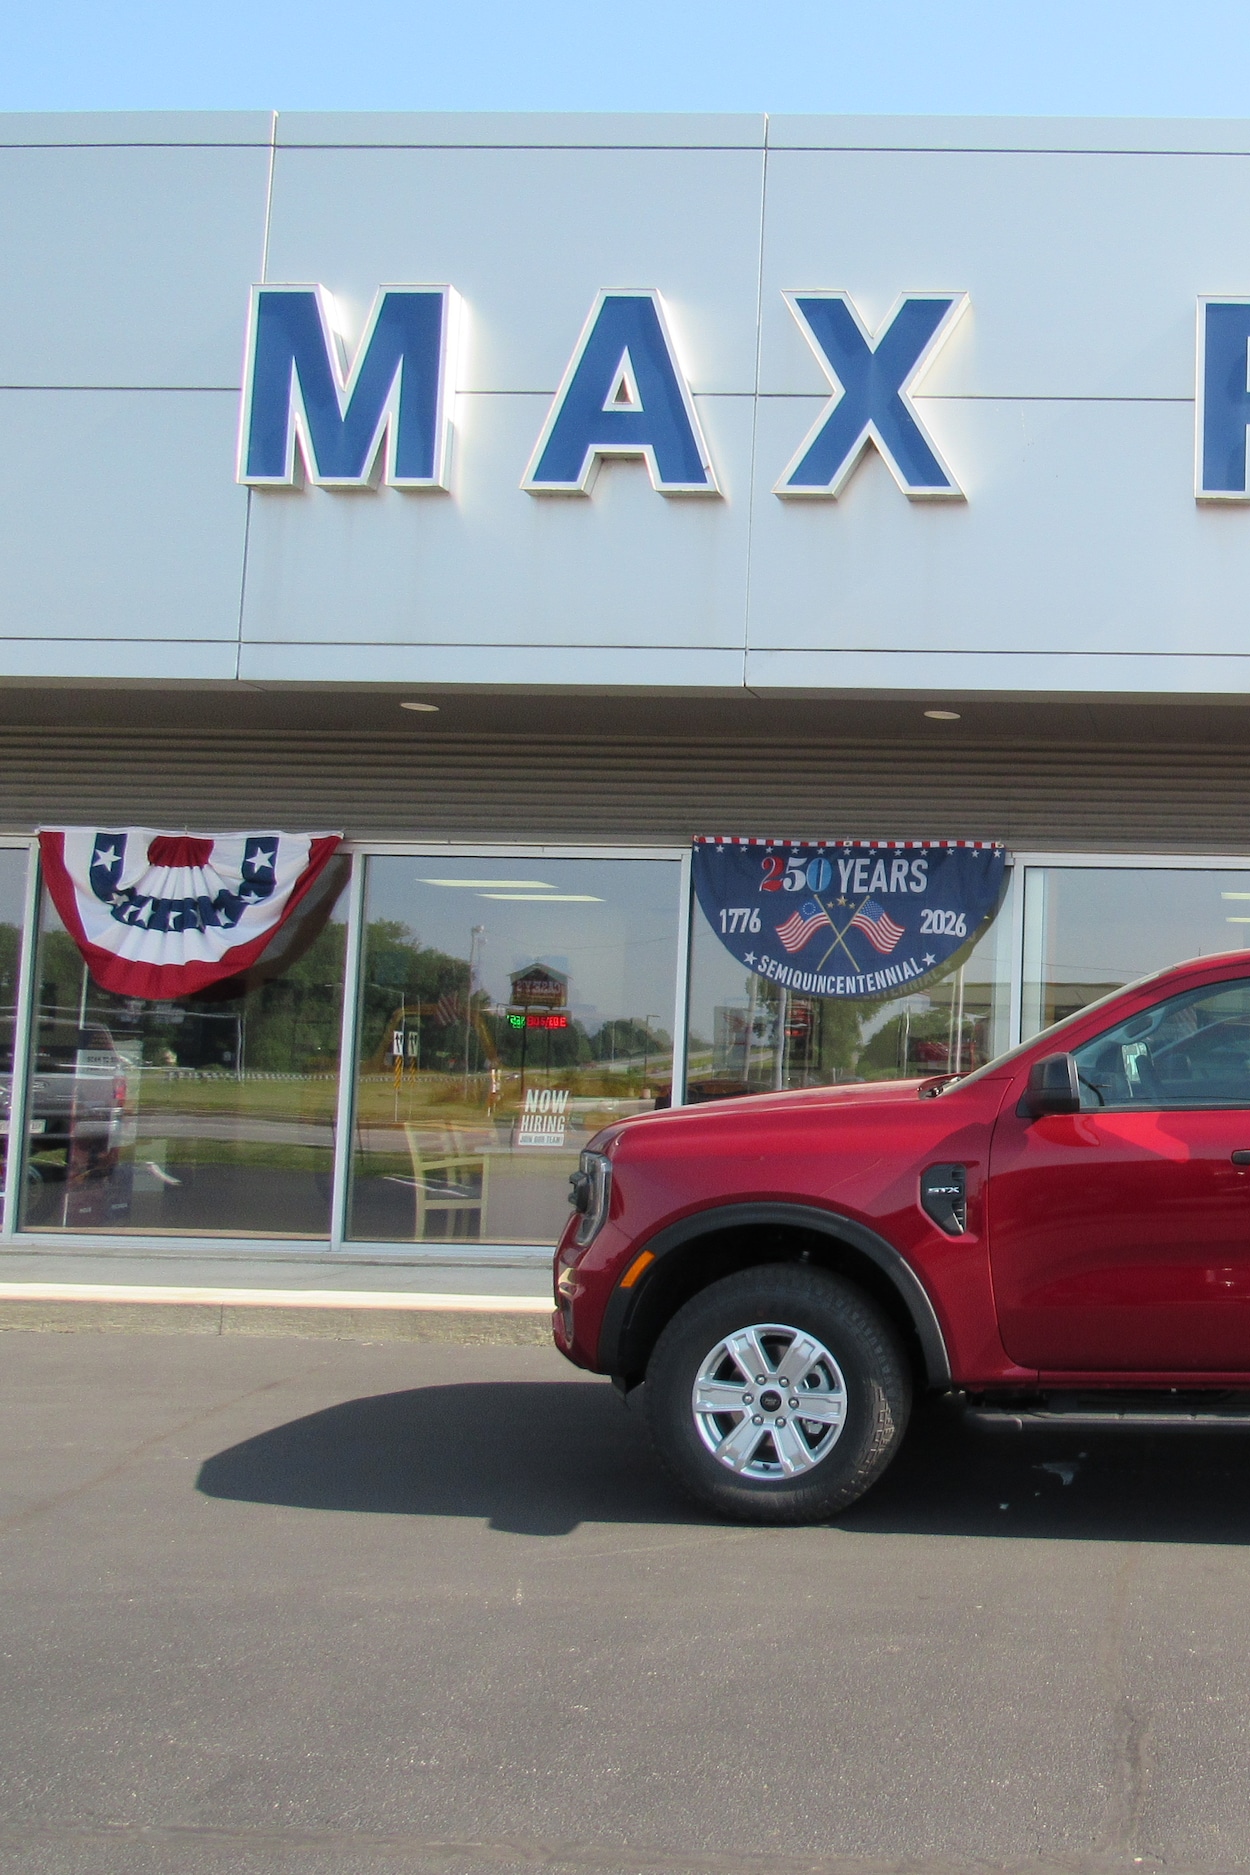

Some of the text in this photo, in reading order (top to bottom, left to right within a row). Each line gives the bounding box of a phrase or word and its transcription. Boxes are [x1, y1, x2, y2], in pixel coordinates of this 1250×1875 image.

[236, 283, 969, 500] MAX
[759, 856, 929, 893] 250 YEARS
[719, 908, 968, 938] 1776 2026
[757, 954, 924, 995] SEMIQUINCENTENNIAL
[525, 1089, 570, 1114] NOW
[520, 1115, 566, 1133] HIRING
